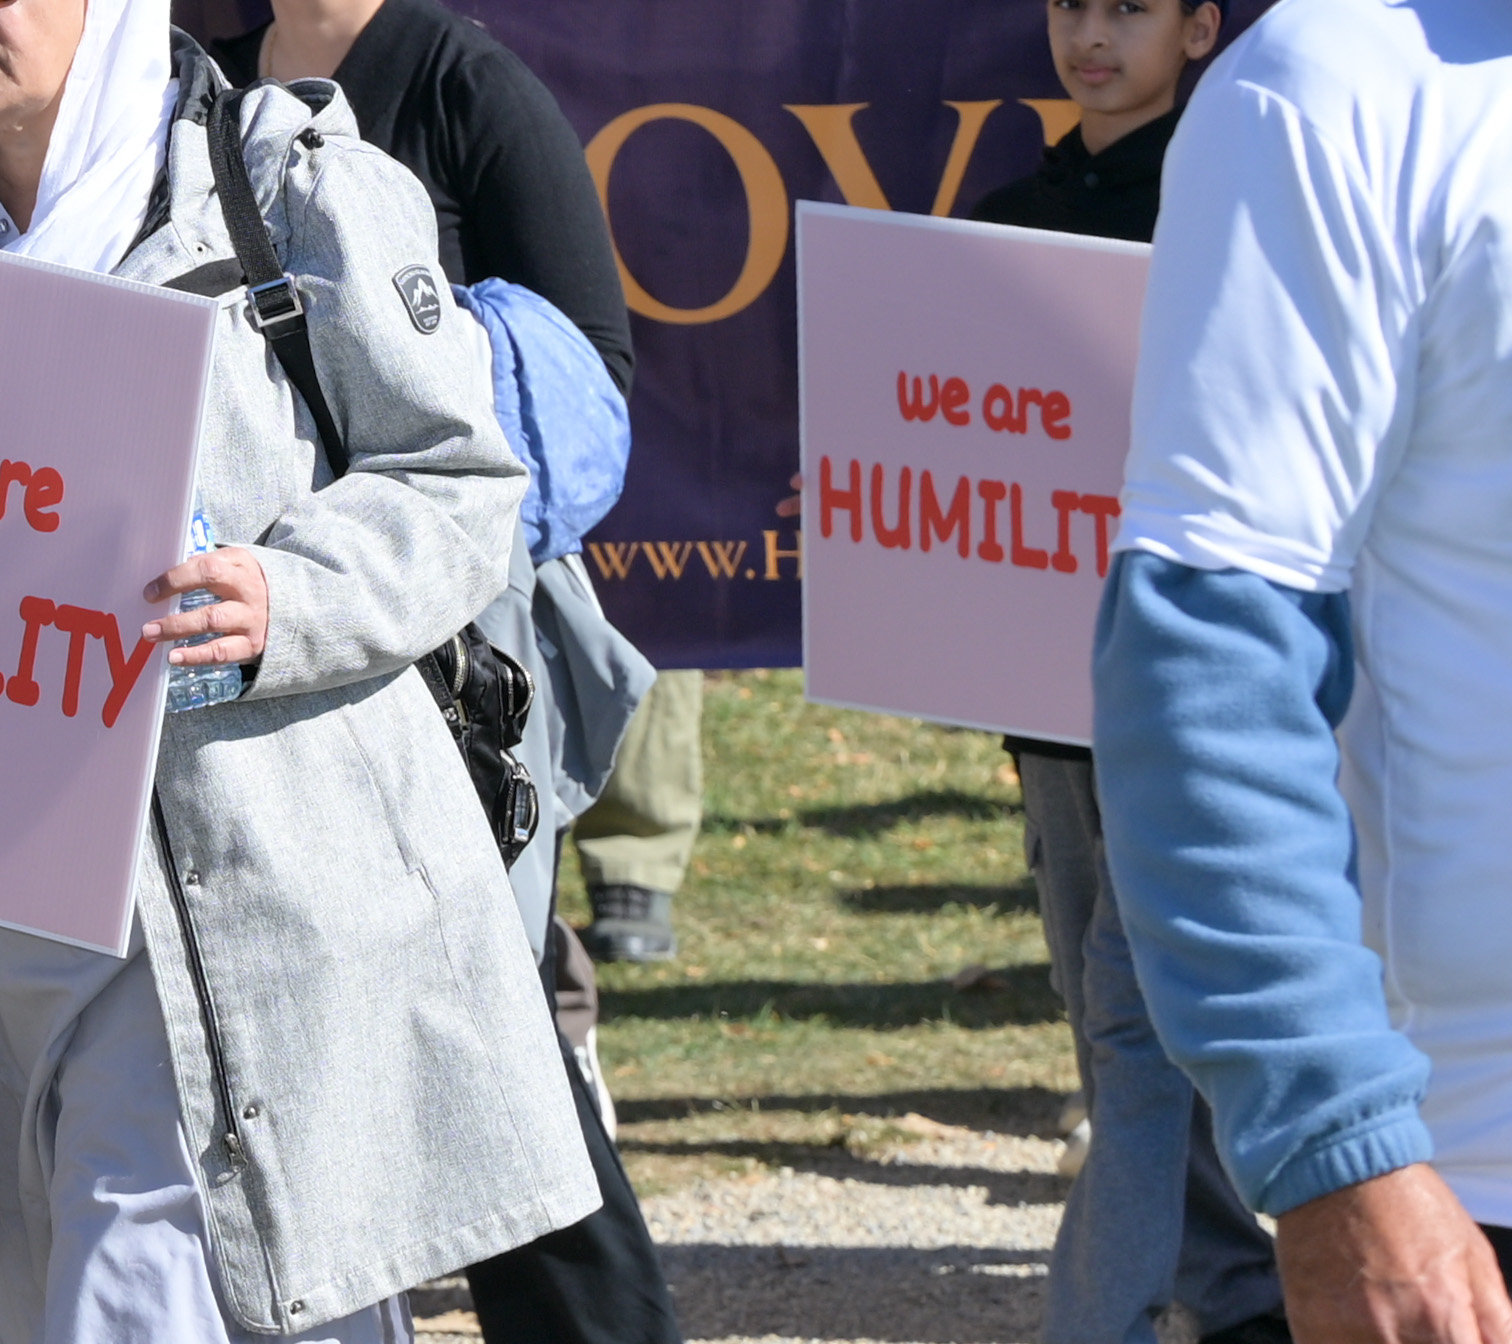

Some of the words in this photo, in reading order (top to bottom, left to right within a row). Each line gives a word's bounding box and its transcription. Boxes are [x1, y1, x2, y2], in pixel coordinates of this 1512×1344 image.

[582, 98, 1084, 324] OV
[896, 370, 971, 426] we
[982, 383, 1072, 441] are
[587, 529, 802, 581] www.H
[818, 455, 1122, 578] HUMILIT
